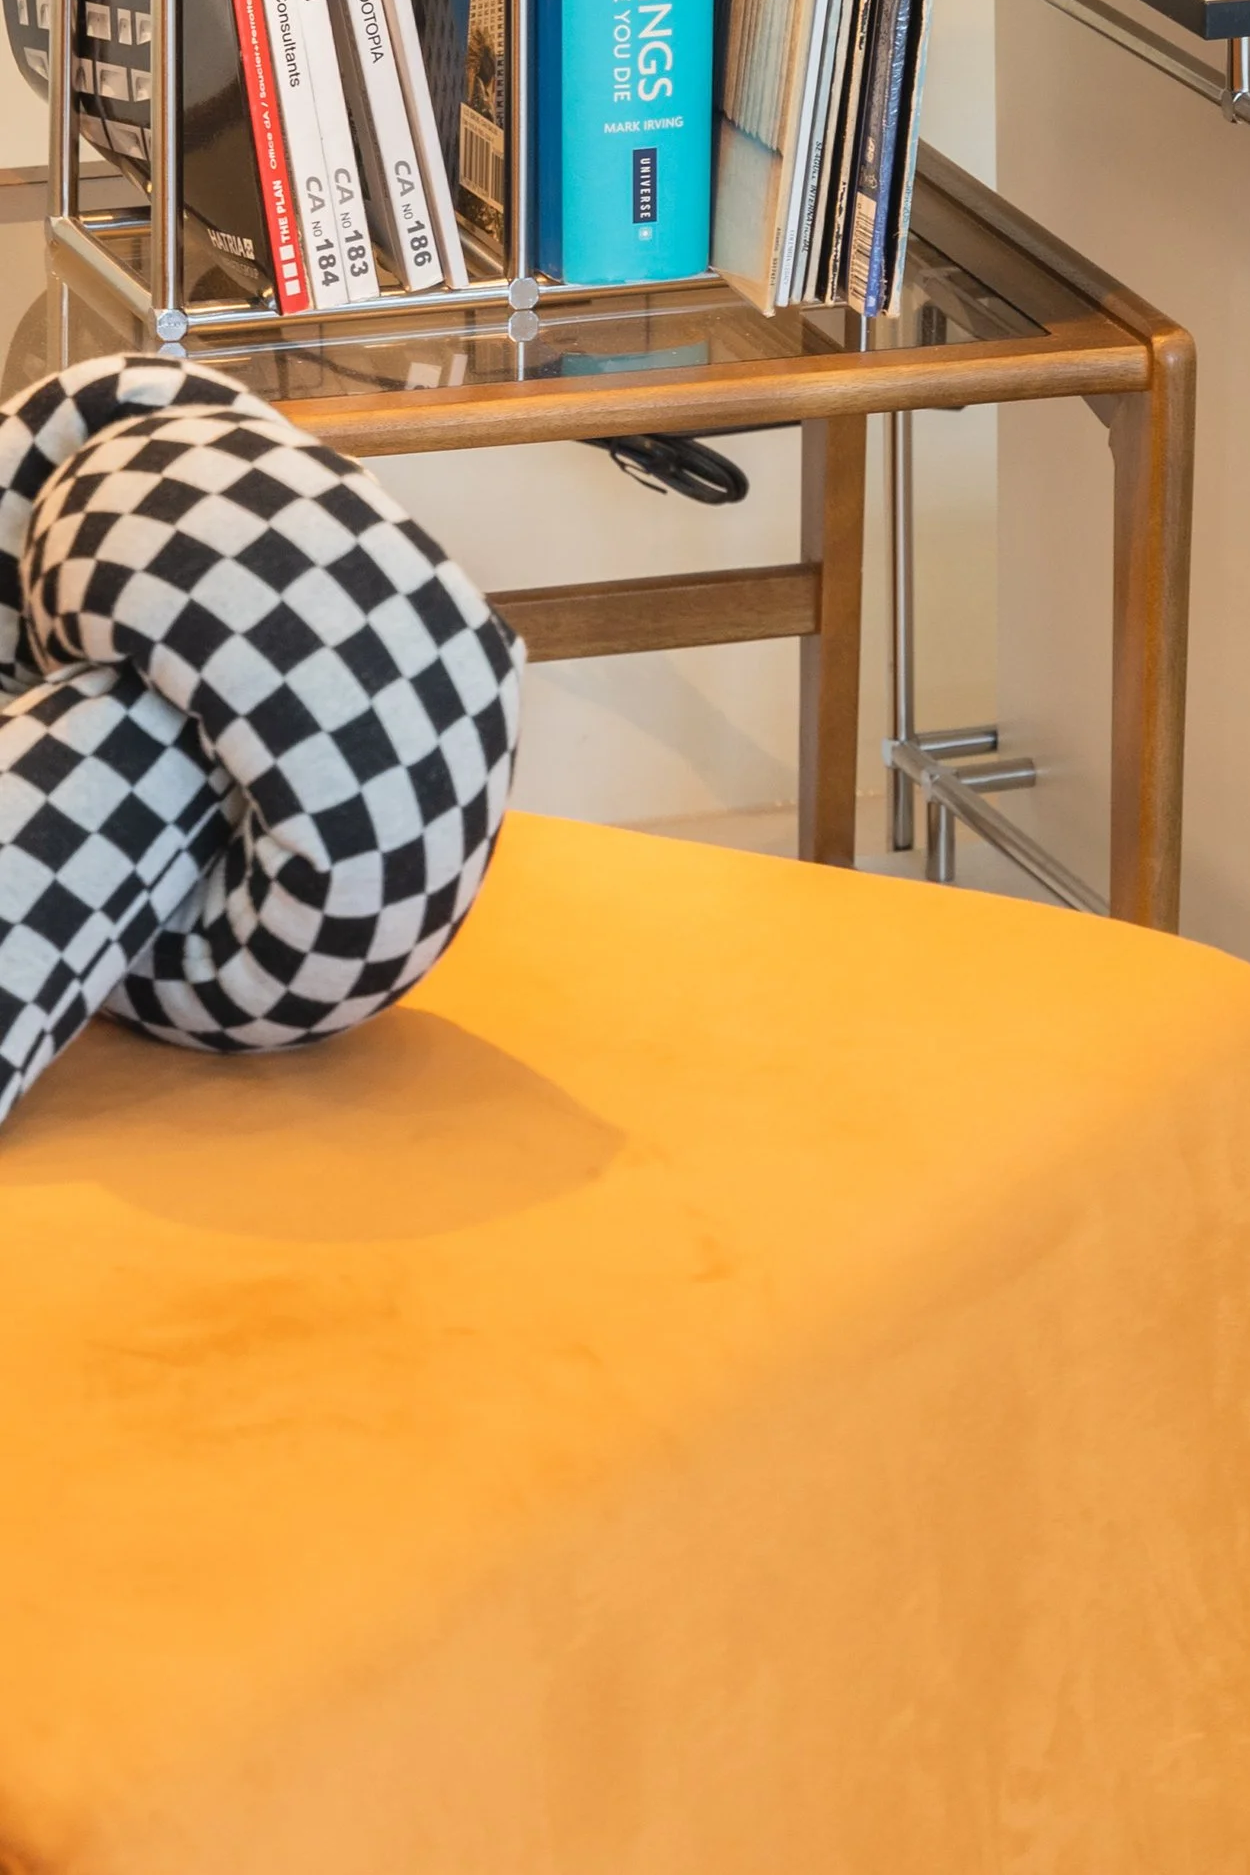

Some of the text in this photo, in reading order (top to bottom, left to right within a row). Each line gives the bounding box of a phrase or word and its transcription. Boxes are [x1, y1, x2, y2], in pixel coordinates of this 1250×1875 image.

[613, 9, 631, 59] YOU
[613, 67, 631, 103] DIE
[266, 132, 277, 170] Office
[603, 116, 684, 133] MARK IRVING
[273, 179, 290, 243] THE PLAN
[394, 160, 432, 267] CA NO 186
[640, 157, 651, 219] UNIVERSE
[207, 229, 246, 257] HATRIA
[305, 176, 340, 287] CA NO 184
[334, 168, 369, 277] CA NO 183
